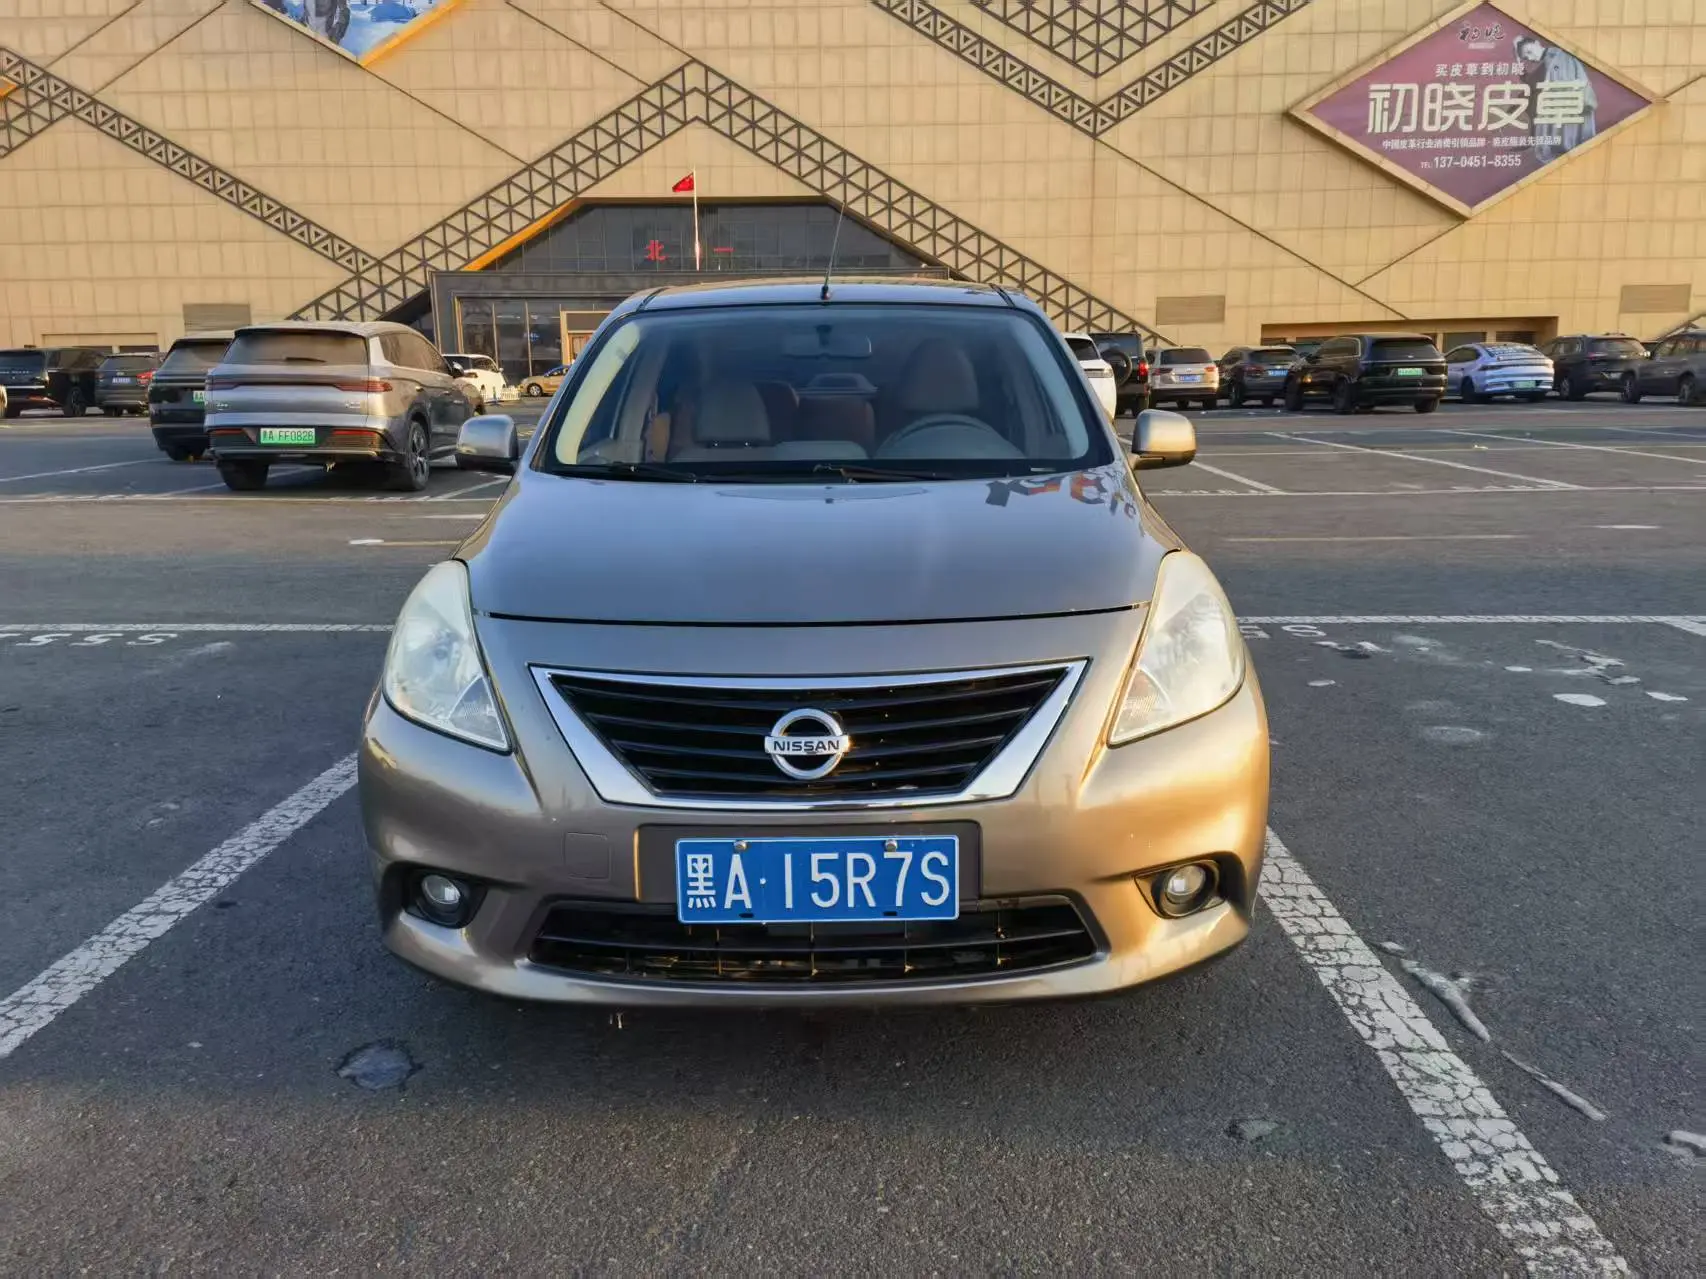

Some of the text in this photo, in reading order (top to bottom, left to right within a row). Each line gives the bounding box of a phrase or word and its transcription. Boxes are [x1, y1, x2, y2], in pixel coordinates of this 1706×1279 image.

[1367, 80, 1587, 133] 初晓皮草
[1433, 154, 1521, 169] 137-0451-8355
[773, 739, 840, 752] NISSAN
[686, 851, 950, 909] 黑A·15R7S
